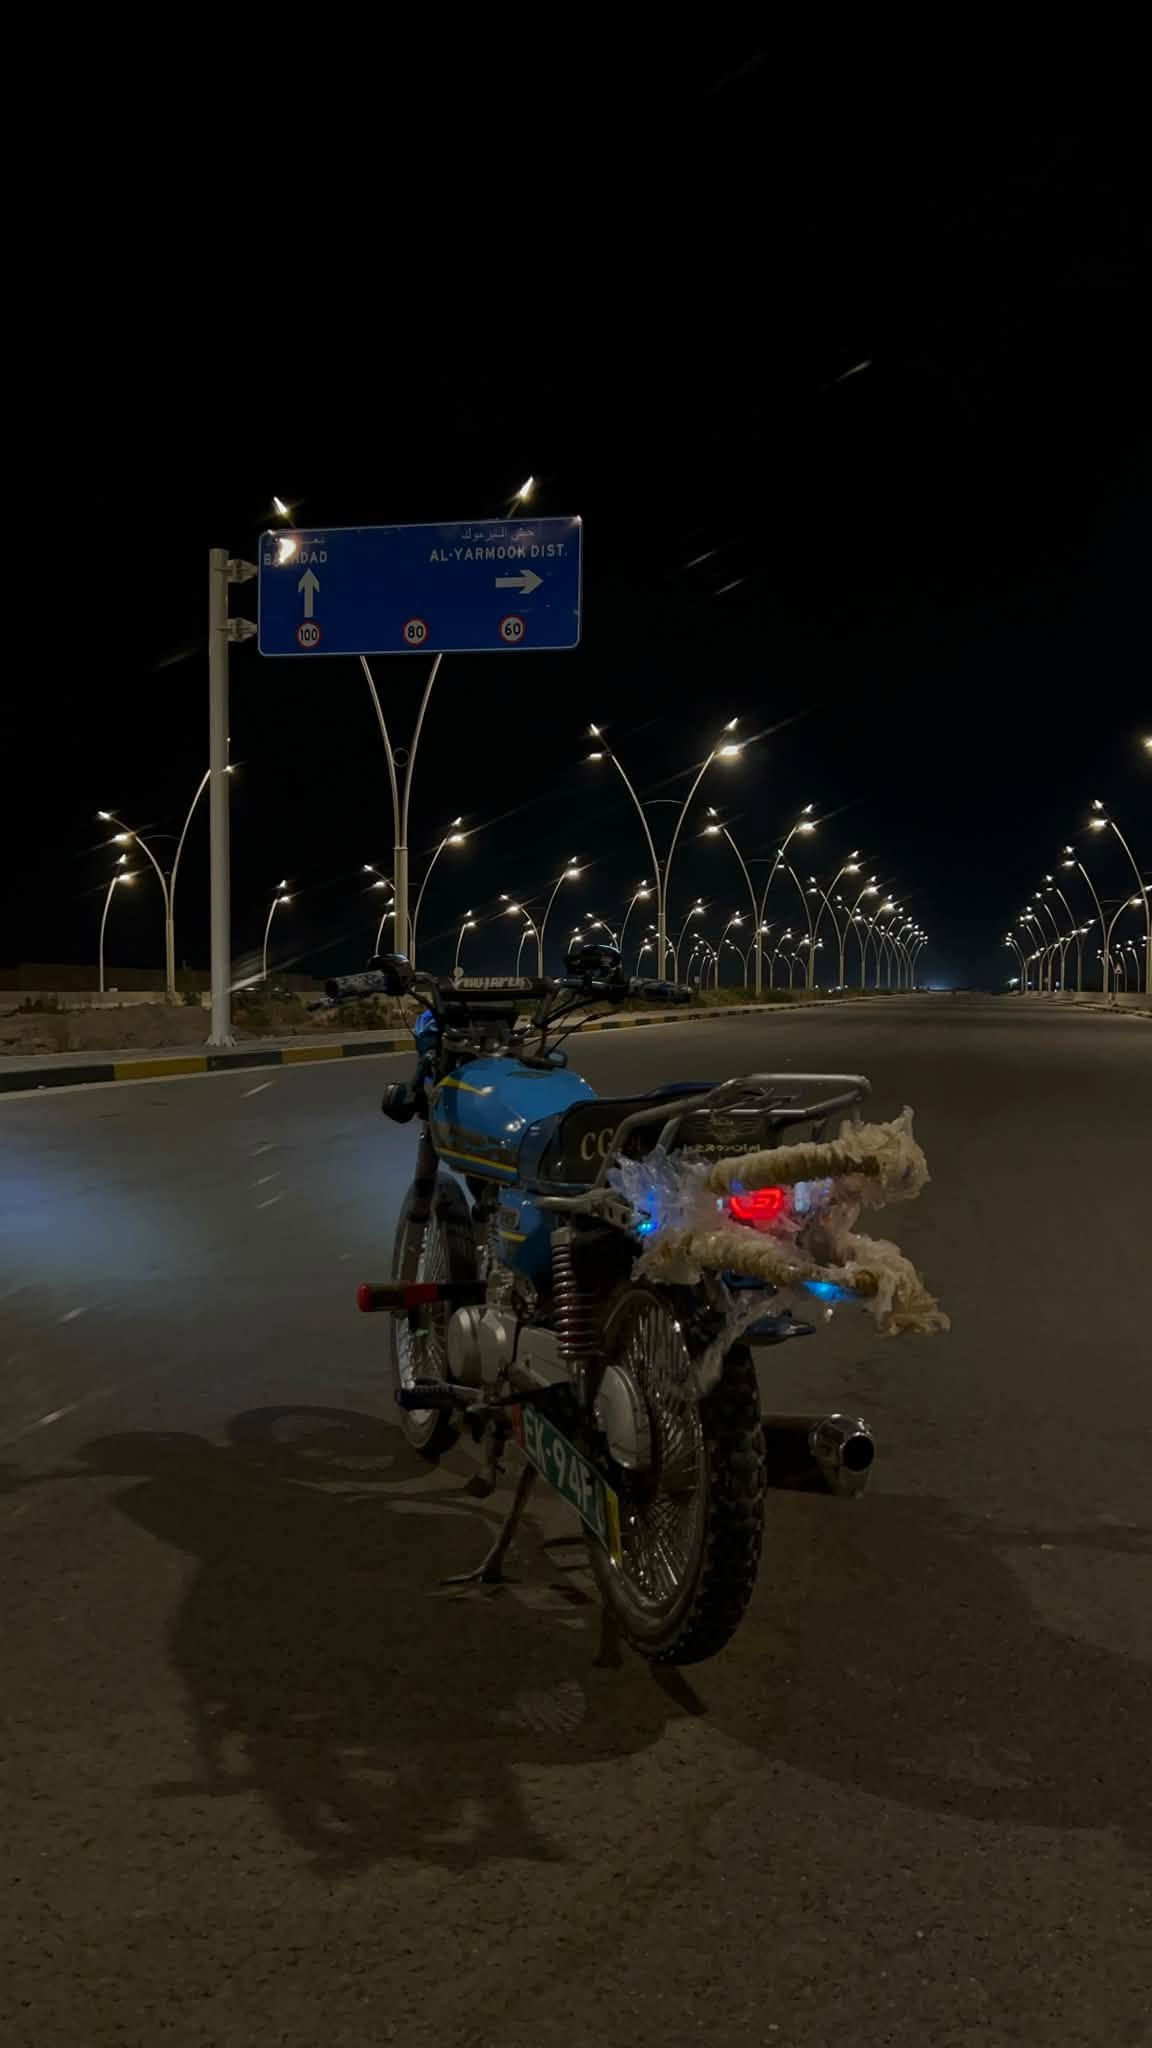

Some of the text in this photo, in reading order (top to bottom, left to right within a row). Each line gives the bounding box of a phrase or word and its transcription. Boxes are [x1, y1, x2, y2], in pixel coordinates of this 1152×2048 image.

[263, 551, 328, 567] BHDAD
[429, 545, 526, 562] AL-YARMOOK
[299, 628, 318, 641] 100
[407, 625, 424, 639] 80
[504, 623, 521, 637] 60
